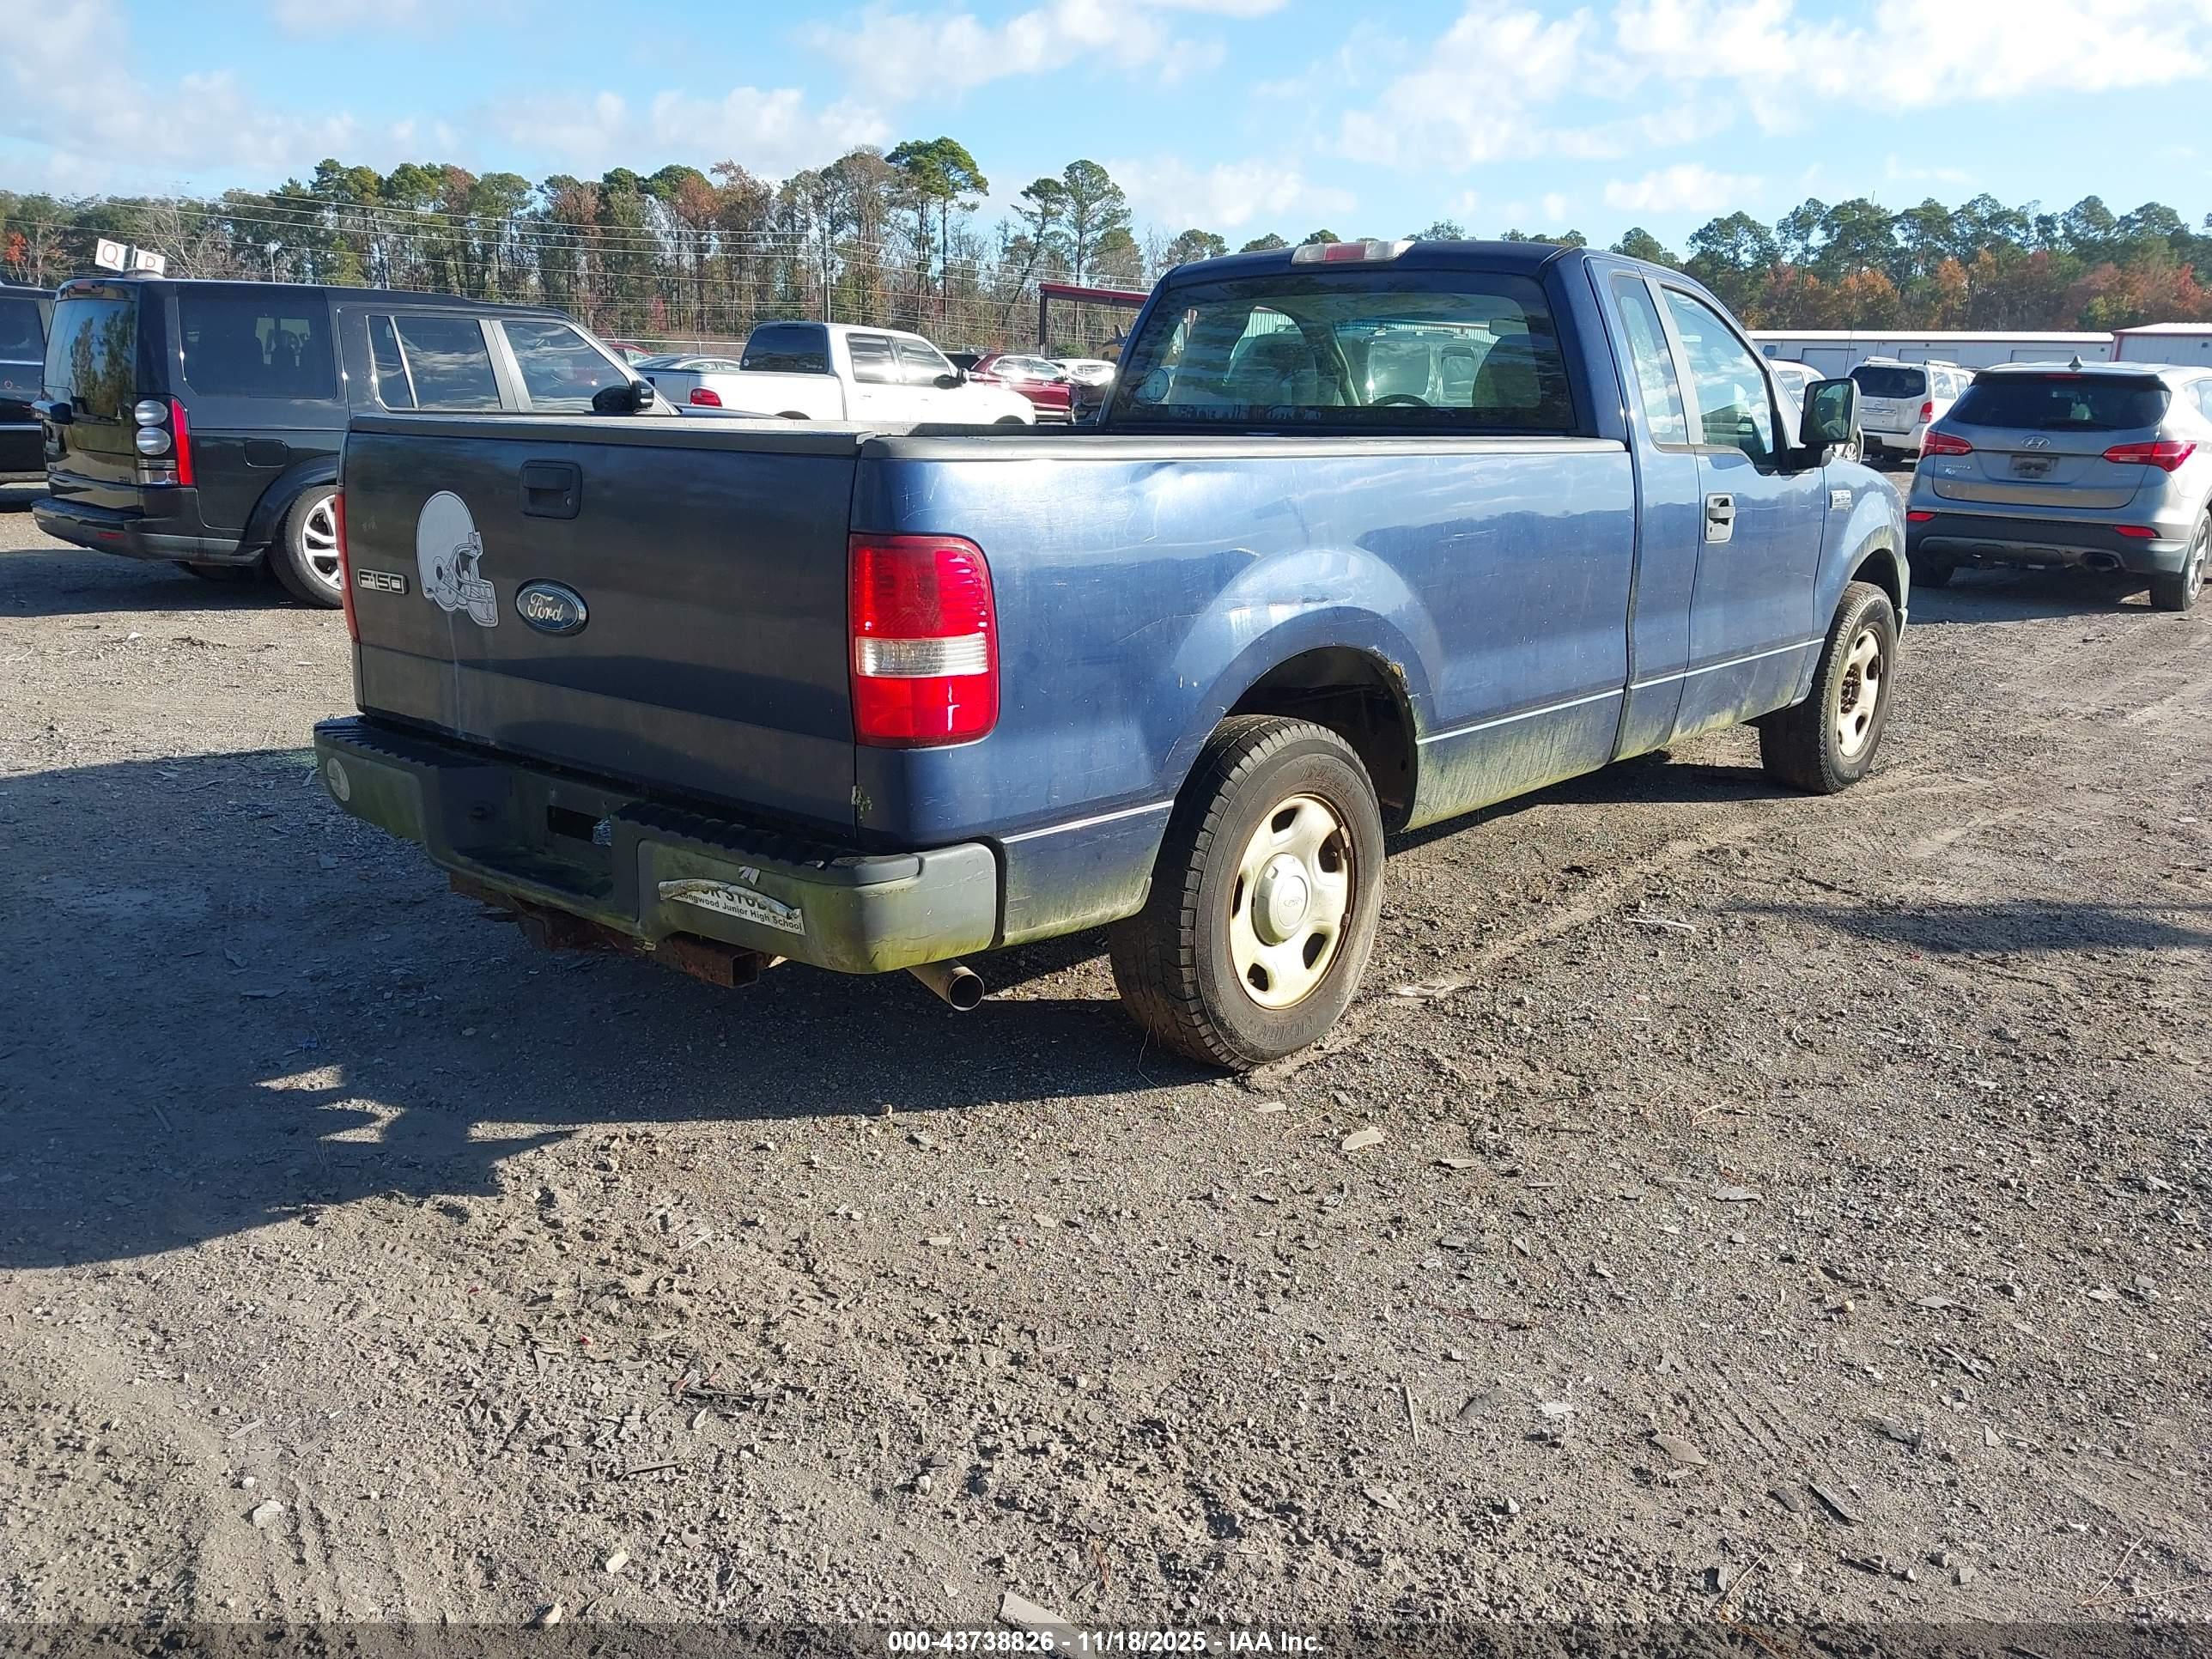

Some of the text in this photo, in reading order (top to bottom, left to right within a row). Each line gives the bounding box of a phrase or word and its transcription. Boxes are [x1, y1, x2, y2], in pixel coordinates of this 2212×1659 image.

[102, 243, 118, 268] Q
[527, 592, 564, 622] Ford
[722, 902, 748, 915] Junior
[750, 908, 771, 923] High
[772, 915, 803, 932] School
